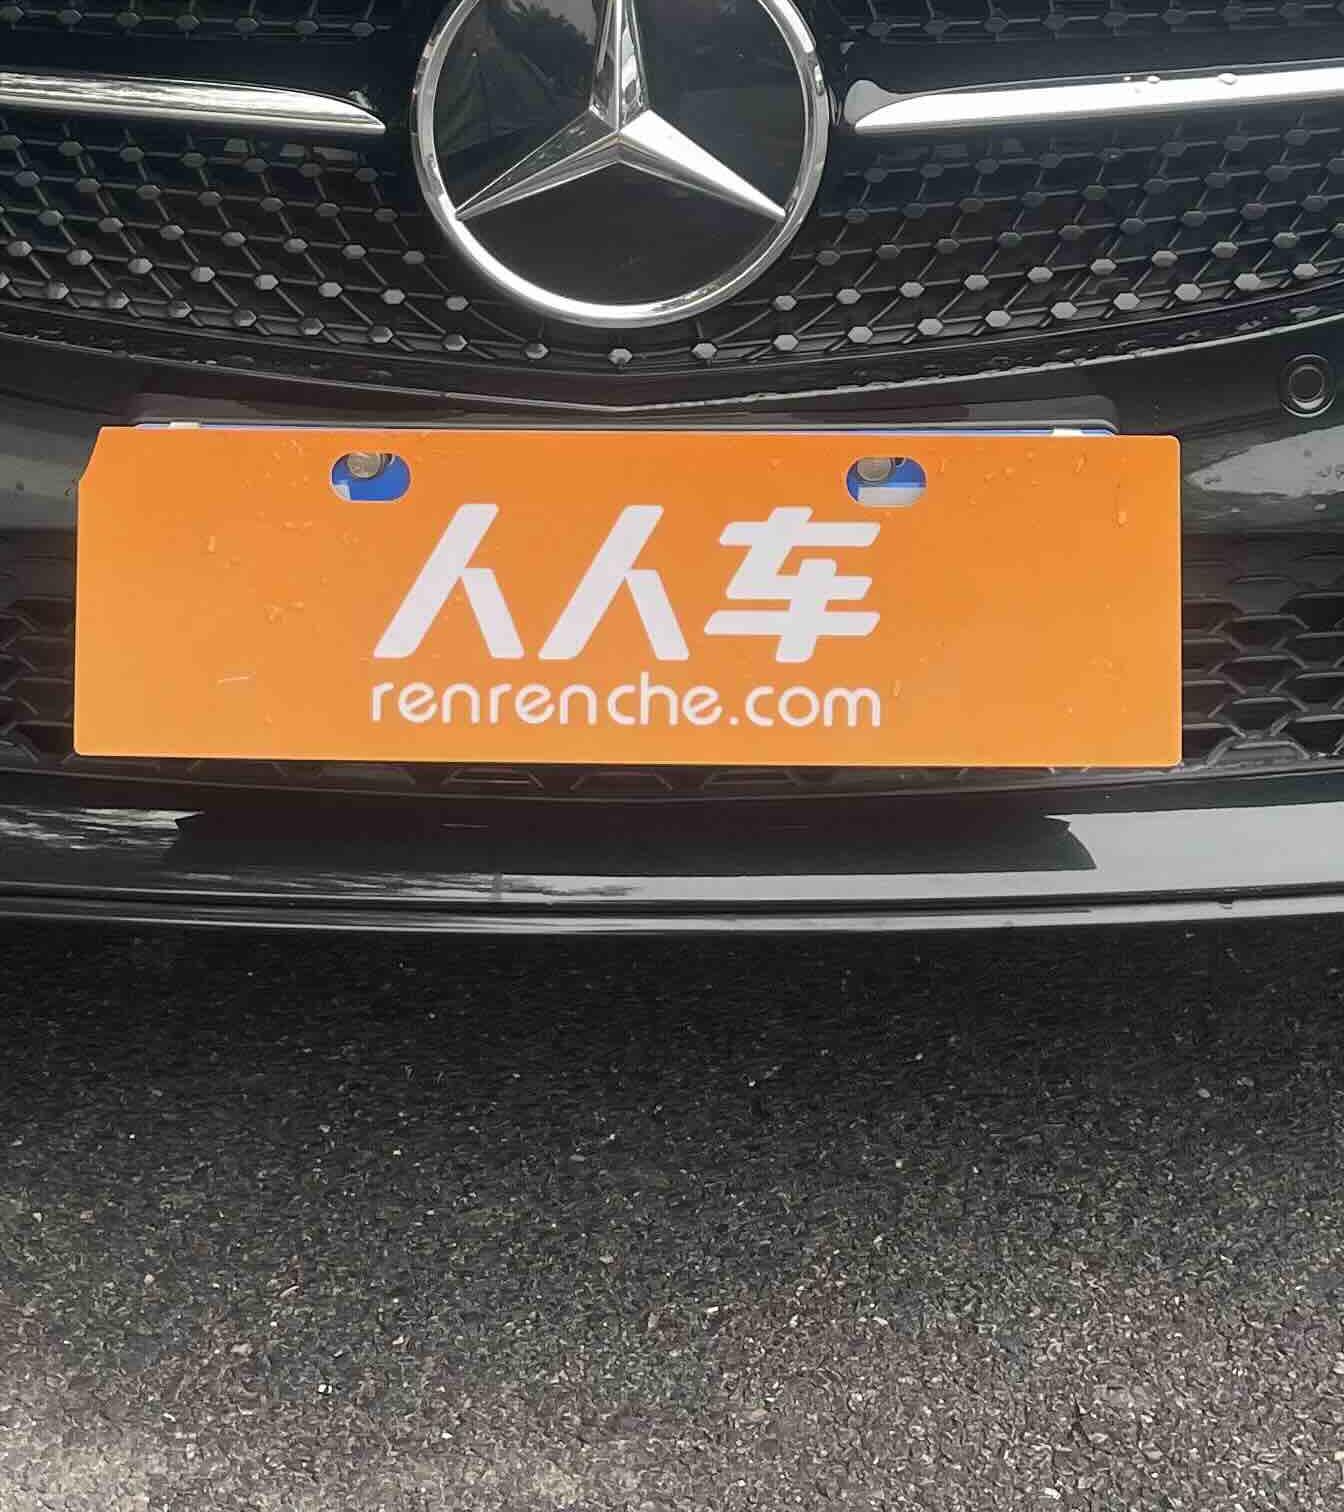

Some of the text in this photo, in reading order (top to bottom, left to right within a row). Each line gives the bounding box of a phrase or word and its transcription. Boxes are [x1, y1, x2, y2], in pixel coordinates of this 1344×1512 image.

[374, 503, 881, 662] 人人车
[372, 672, 881, 727] renrenche.com
